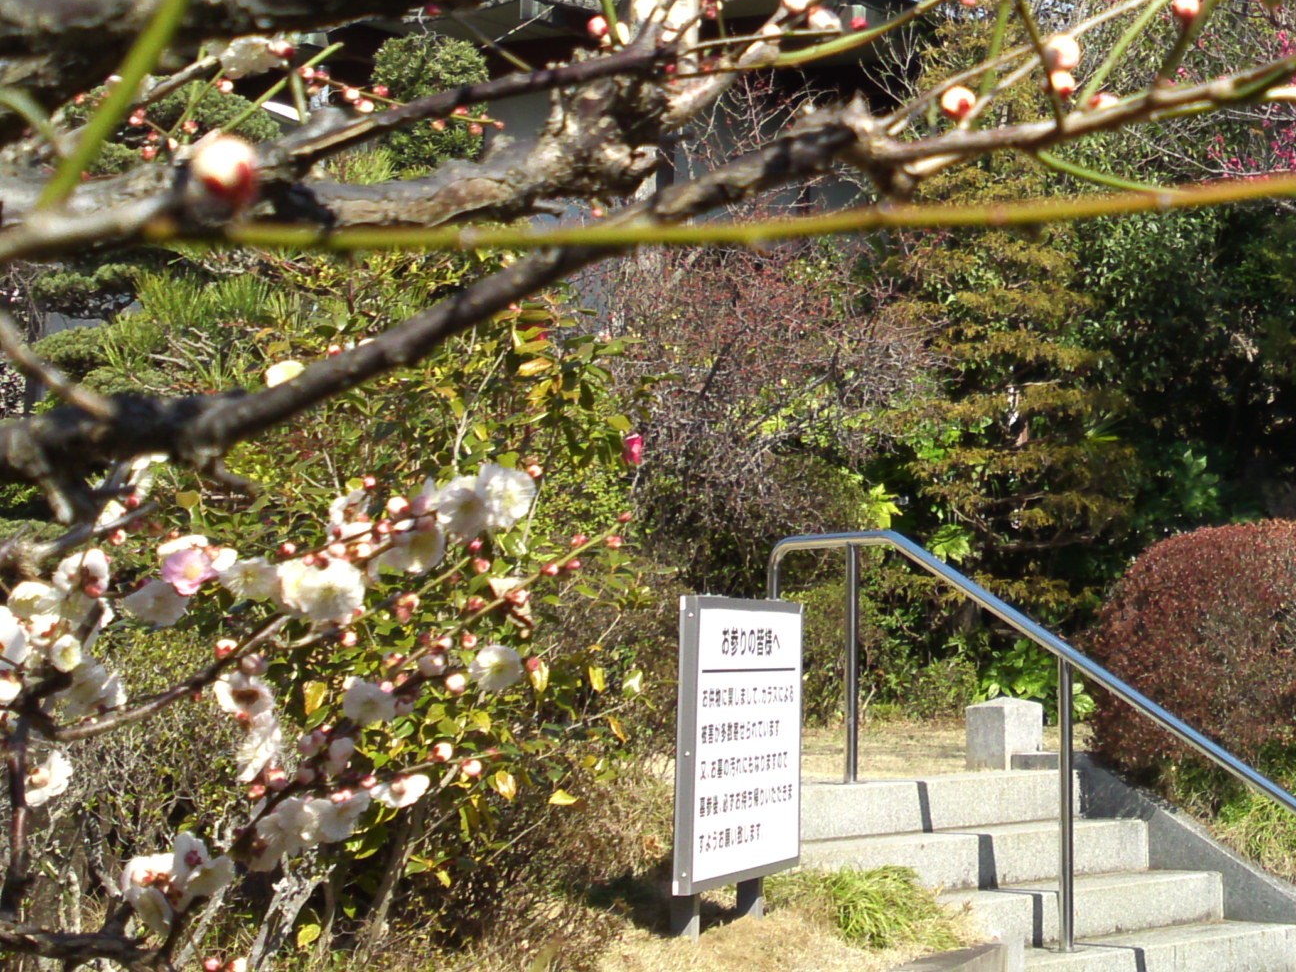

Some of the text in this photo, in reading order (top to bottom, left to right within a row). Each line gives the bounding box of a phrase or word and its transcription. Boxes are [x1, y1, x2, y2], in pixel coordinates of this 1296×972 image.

[721, 626, 781, 656] お参りの皆様へ
